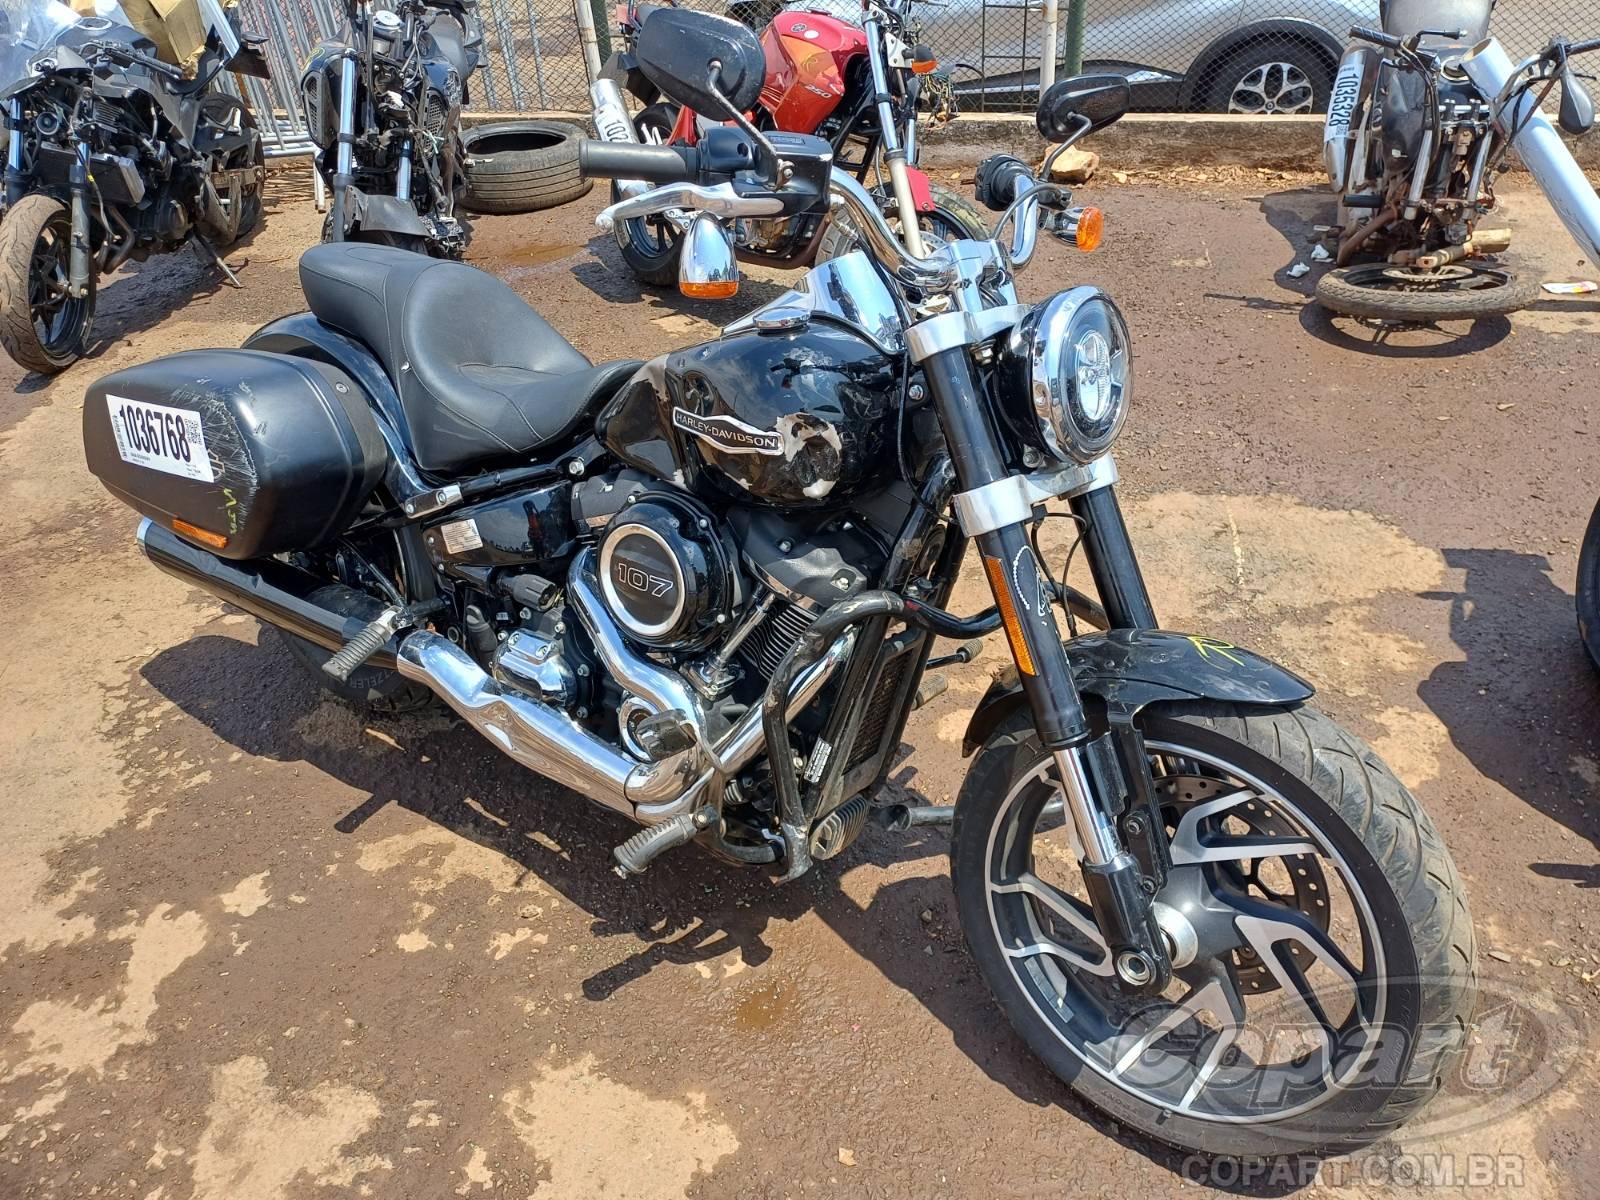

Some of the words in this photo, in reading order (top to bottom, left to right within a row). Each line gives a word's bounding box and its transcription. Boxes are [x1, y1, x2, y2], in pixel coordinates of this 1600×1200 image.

[1328, 73, 1359, 127] 1035328
[119, 404, 191, 463] 1036768
[676, 413, 777, 448] HARLEY-DAVIDSON
[618, 562, 674, 598] 107
